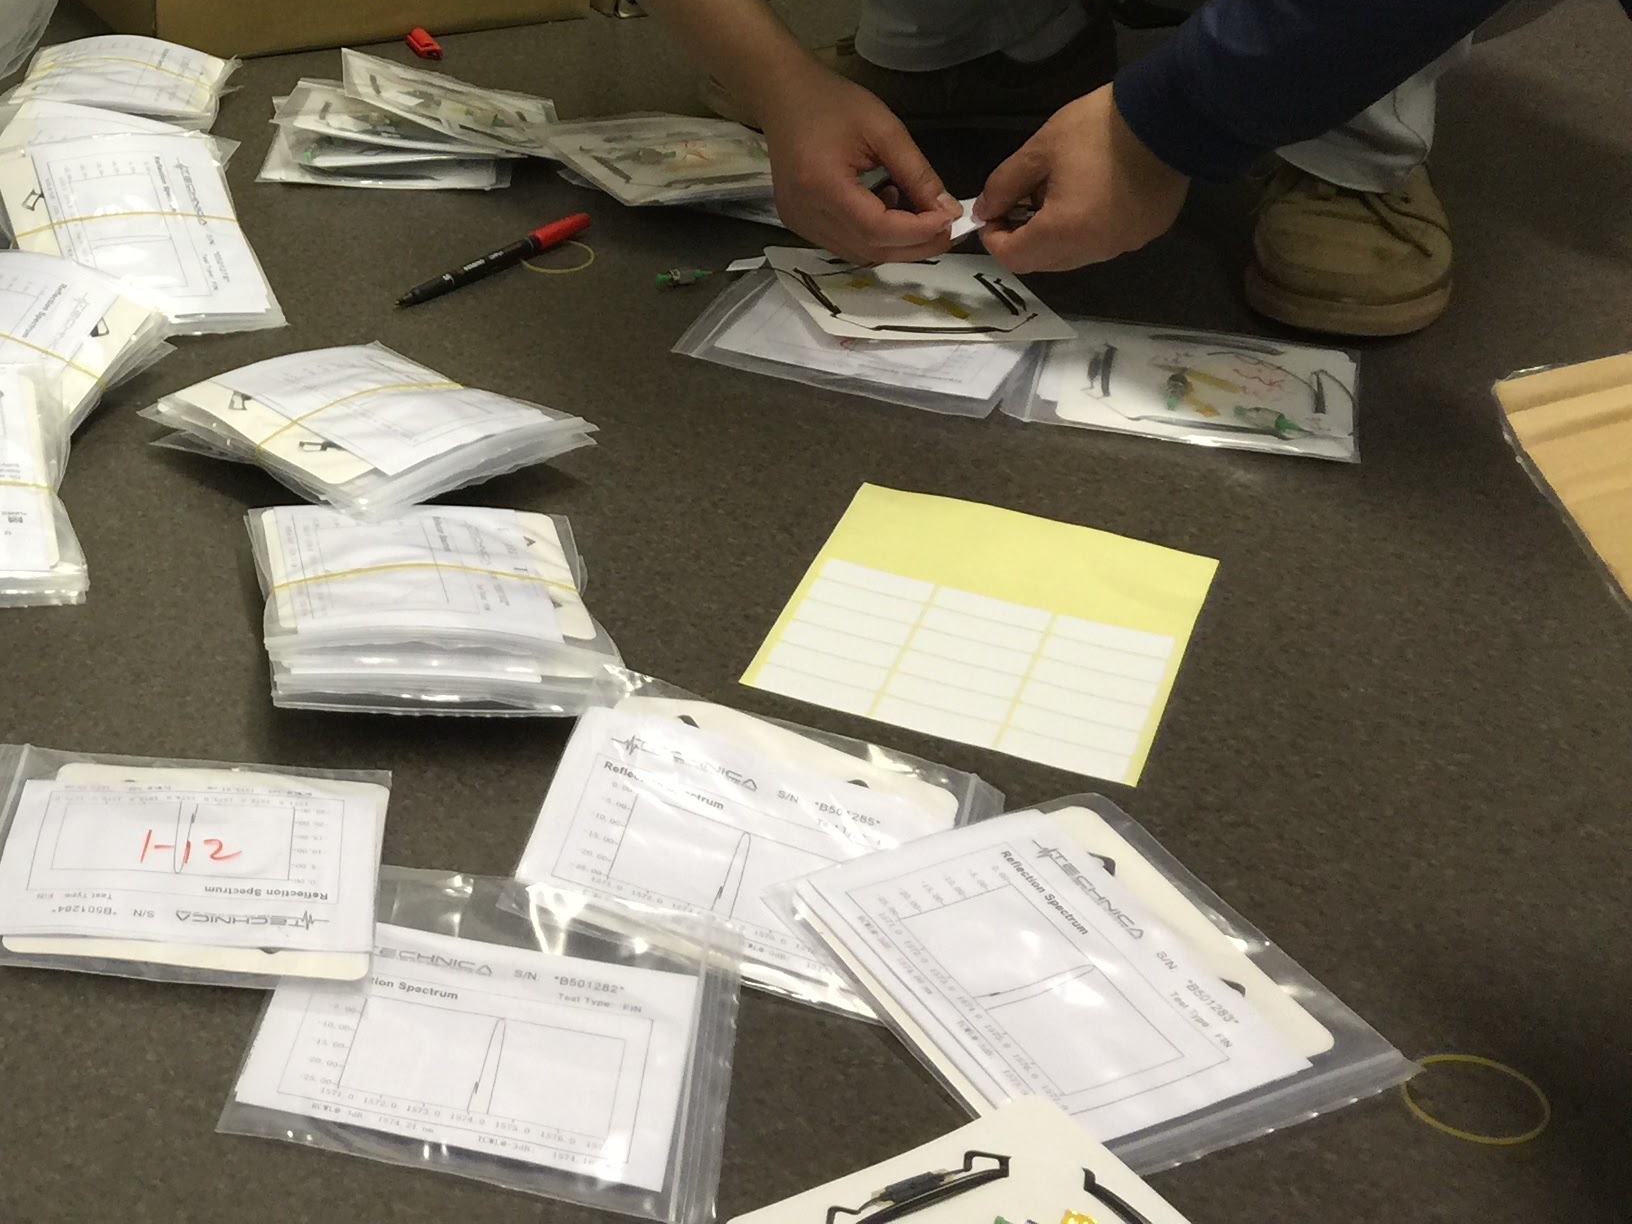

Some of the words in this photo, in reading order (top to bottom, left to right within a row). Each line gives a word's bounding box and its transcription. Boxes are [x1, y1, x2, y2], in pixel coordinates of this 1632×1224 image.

[139, 828, 243, 865] 1-12
[203, 883, 261, 896] Spectrum
[265, 887, 328, 900] Reflection
[998, 847, 1047, 896] Reflection
[1042, 890, 1090, 938] Spectrum
[1048, 846, 1145, 943] TECHNICA
[174, 909, 304, 927] TECHNICA
[397, 981, 459, 1001] Spectrum
